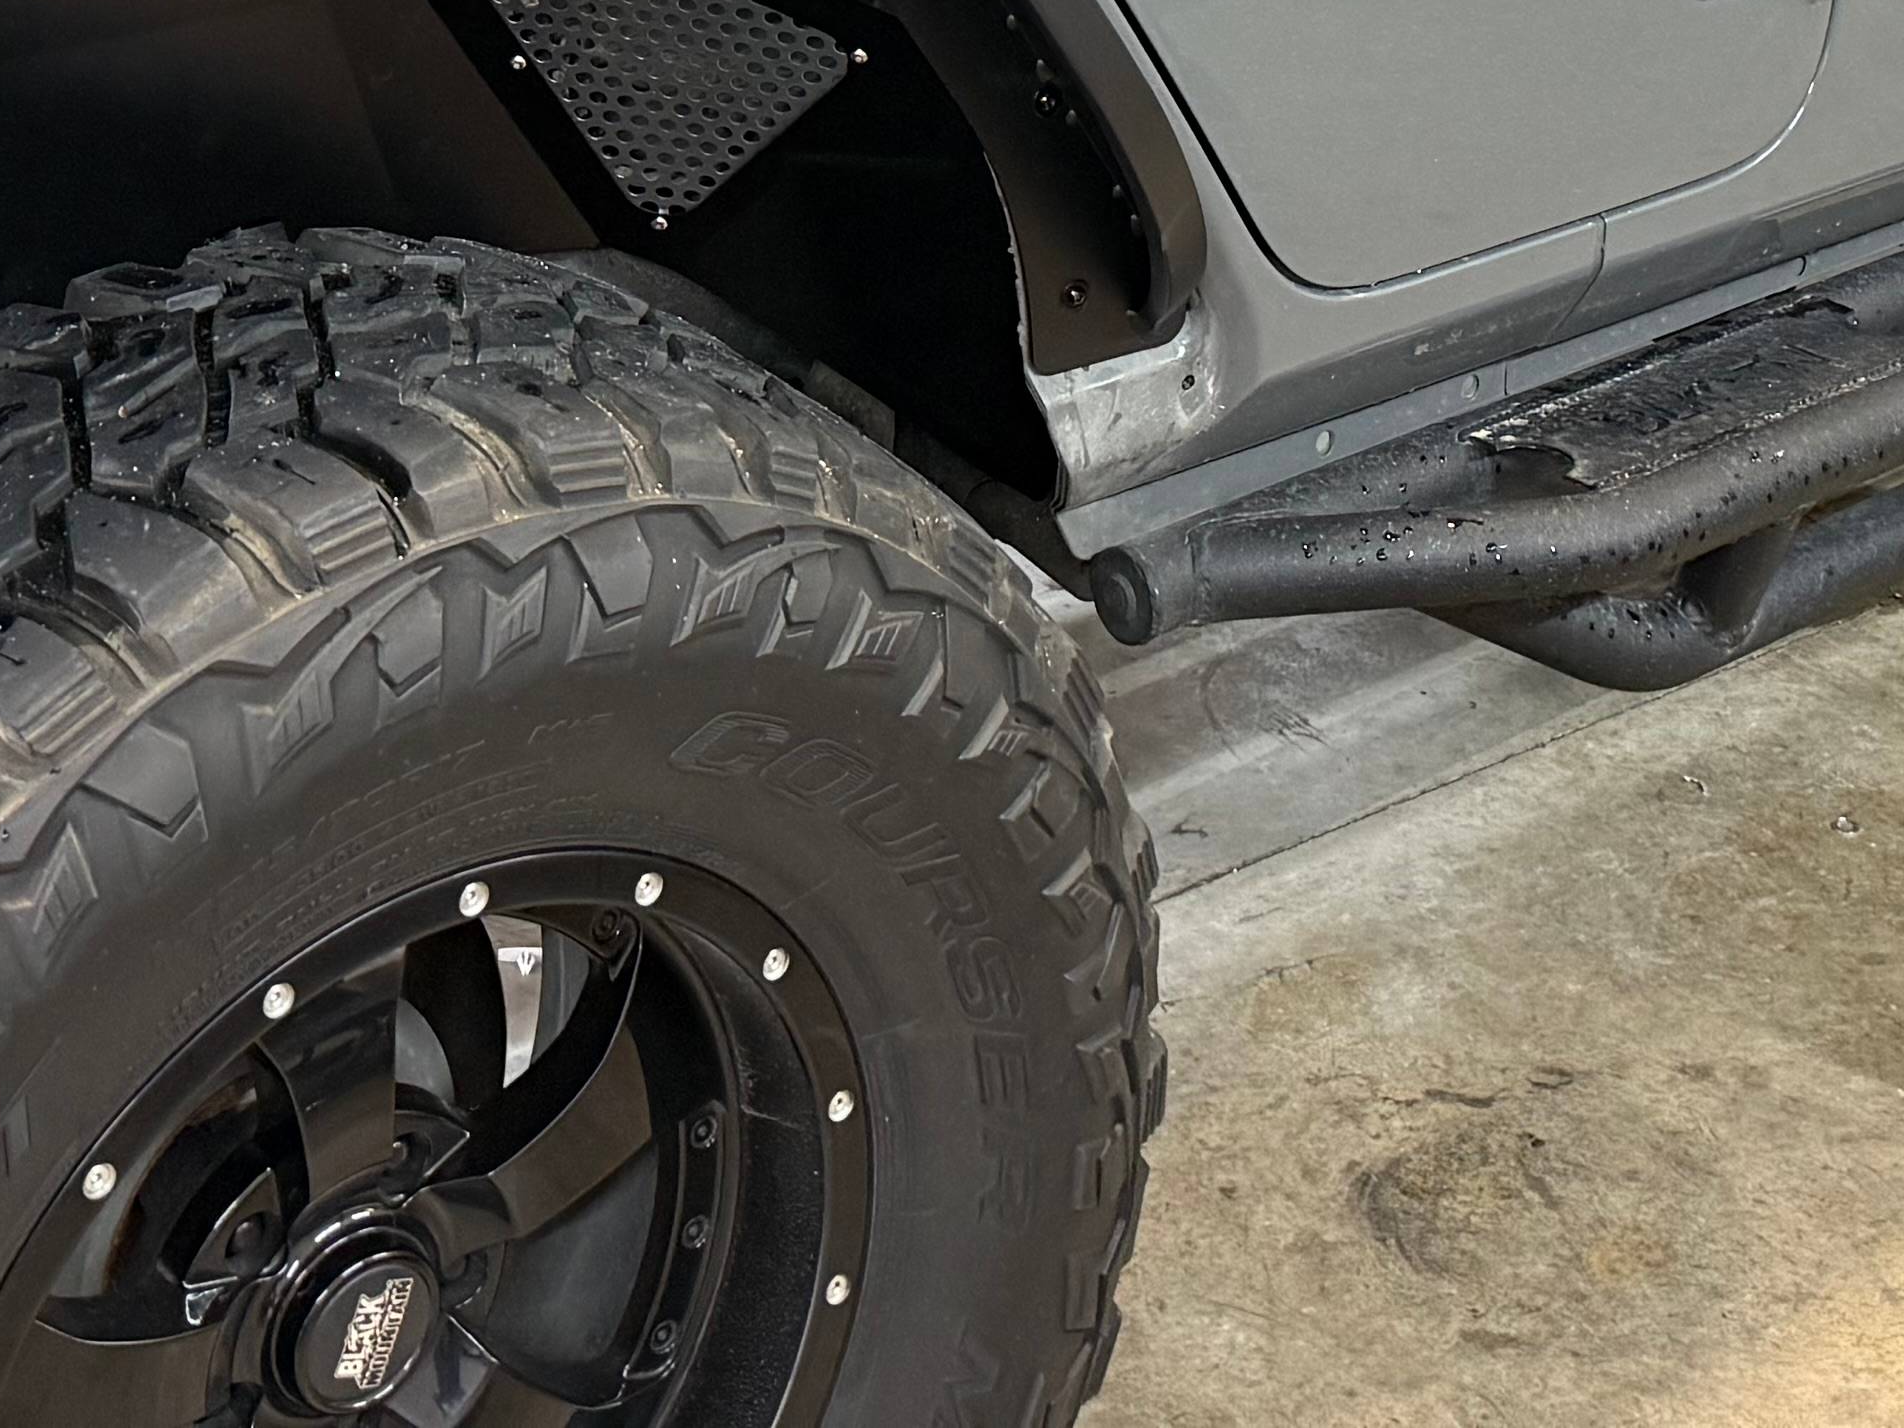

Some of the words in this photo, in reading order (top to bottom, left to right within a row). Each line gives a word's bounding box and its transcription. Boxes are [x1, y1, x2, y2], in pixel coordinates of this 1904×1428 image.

[669, 709, 1028, 1229] COURSER
[334, 1294, 386, 1379] BLACK
[357, 1279, 414, 1389] MOUNTAIN
